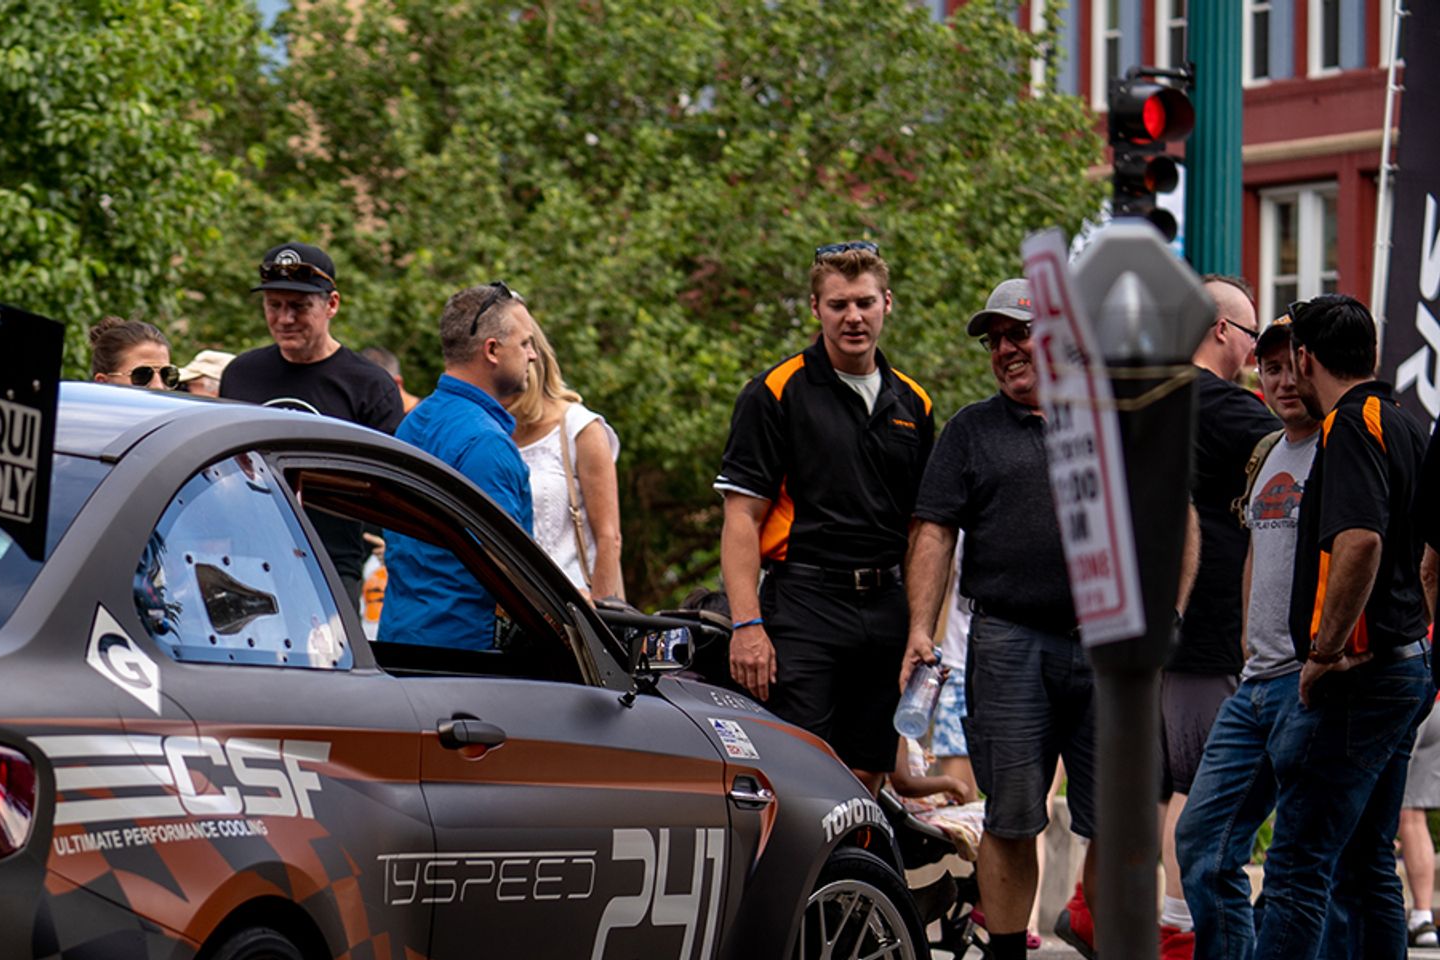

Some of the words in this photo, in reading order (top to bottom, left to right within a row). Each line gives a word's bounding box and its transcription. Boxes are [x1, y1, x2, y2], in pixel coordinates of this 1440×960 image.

[53, 829, 124, 856] ULTIMATE
[124, 821, 220, 847] PERFORMANCE
[220, 819, 269, 838] COOLING
[822, 797, 864, 843] TOYO
